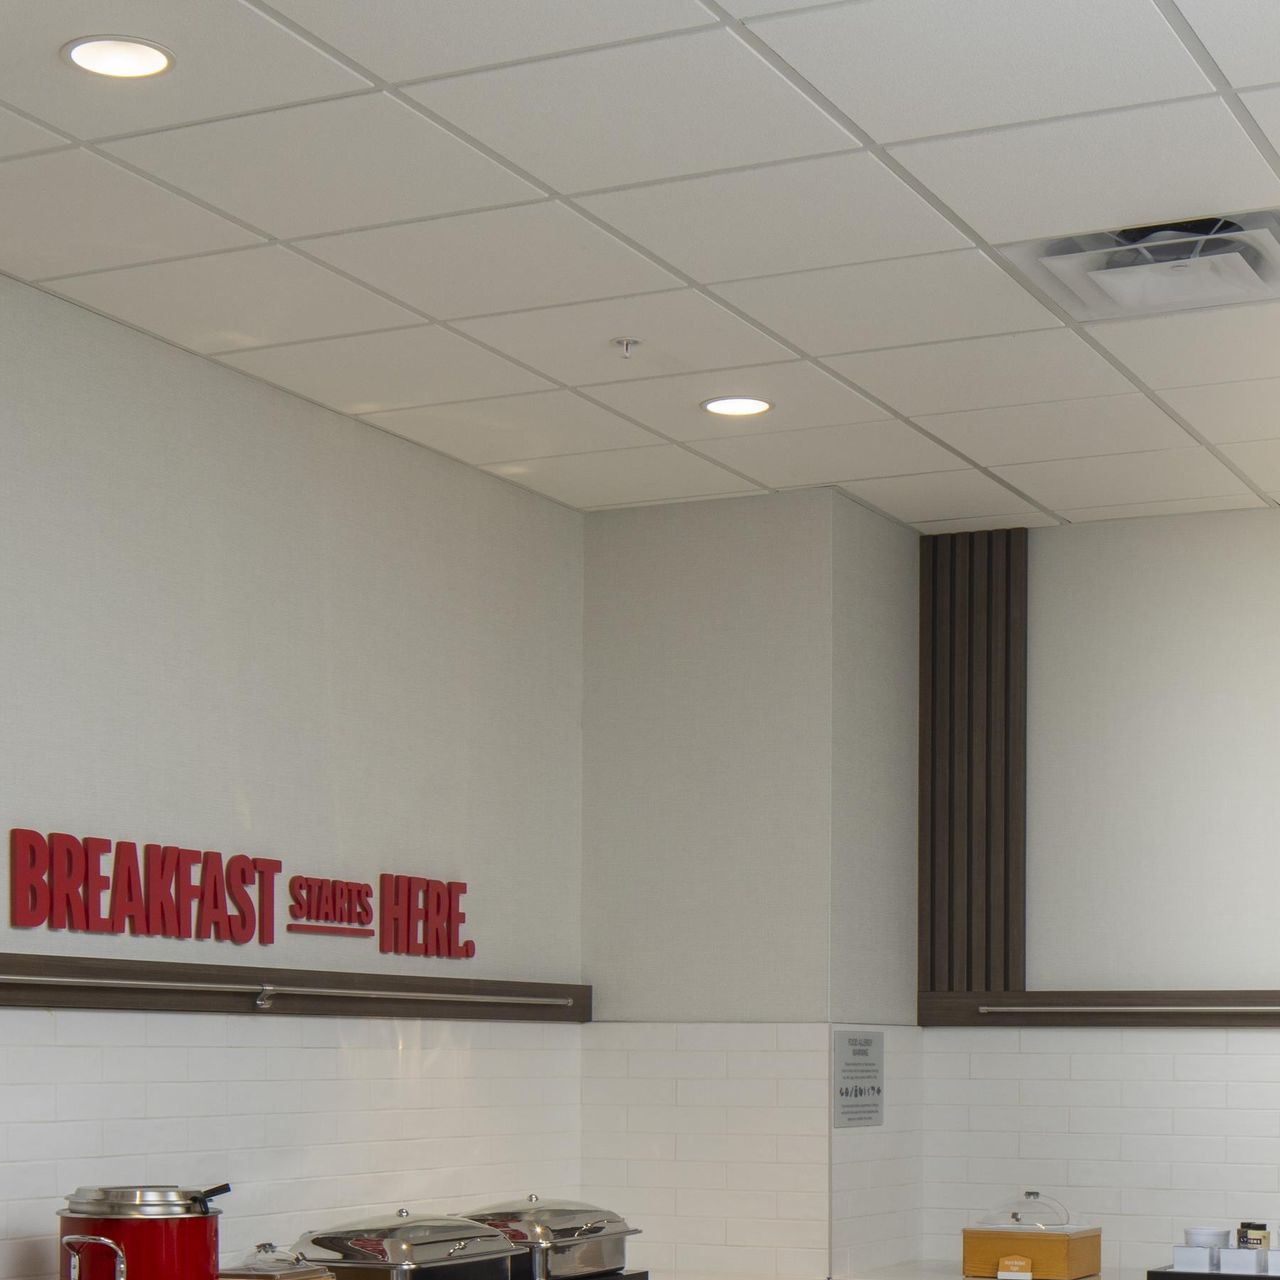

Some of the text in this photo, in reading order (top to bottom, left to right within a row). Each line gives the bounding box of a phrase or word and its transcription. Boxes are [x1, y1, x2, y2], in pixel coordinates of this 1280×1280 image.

[9, 828, 282, 945] BREAKFAST
[288, 875, 373, 926] STARTS
[379, 873, 475, 958] HERE.
